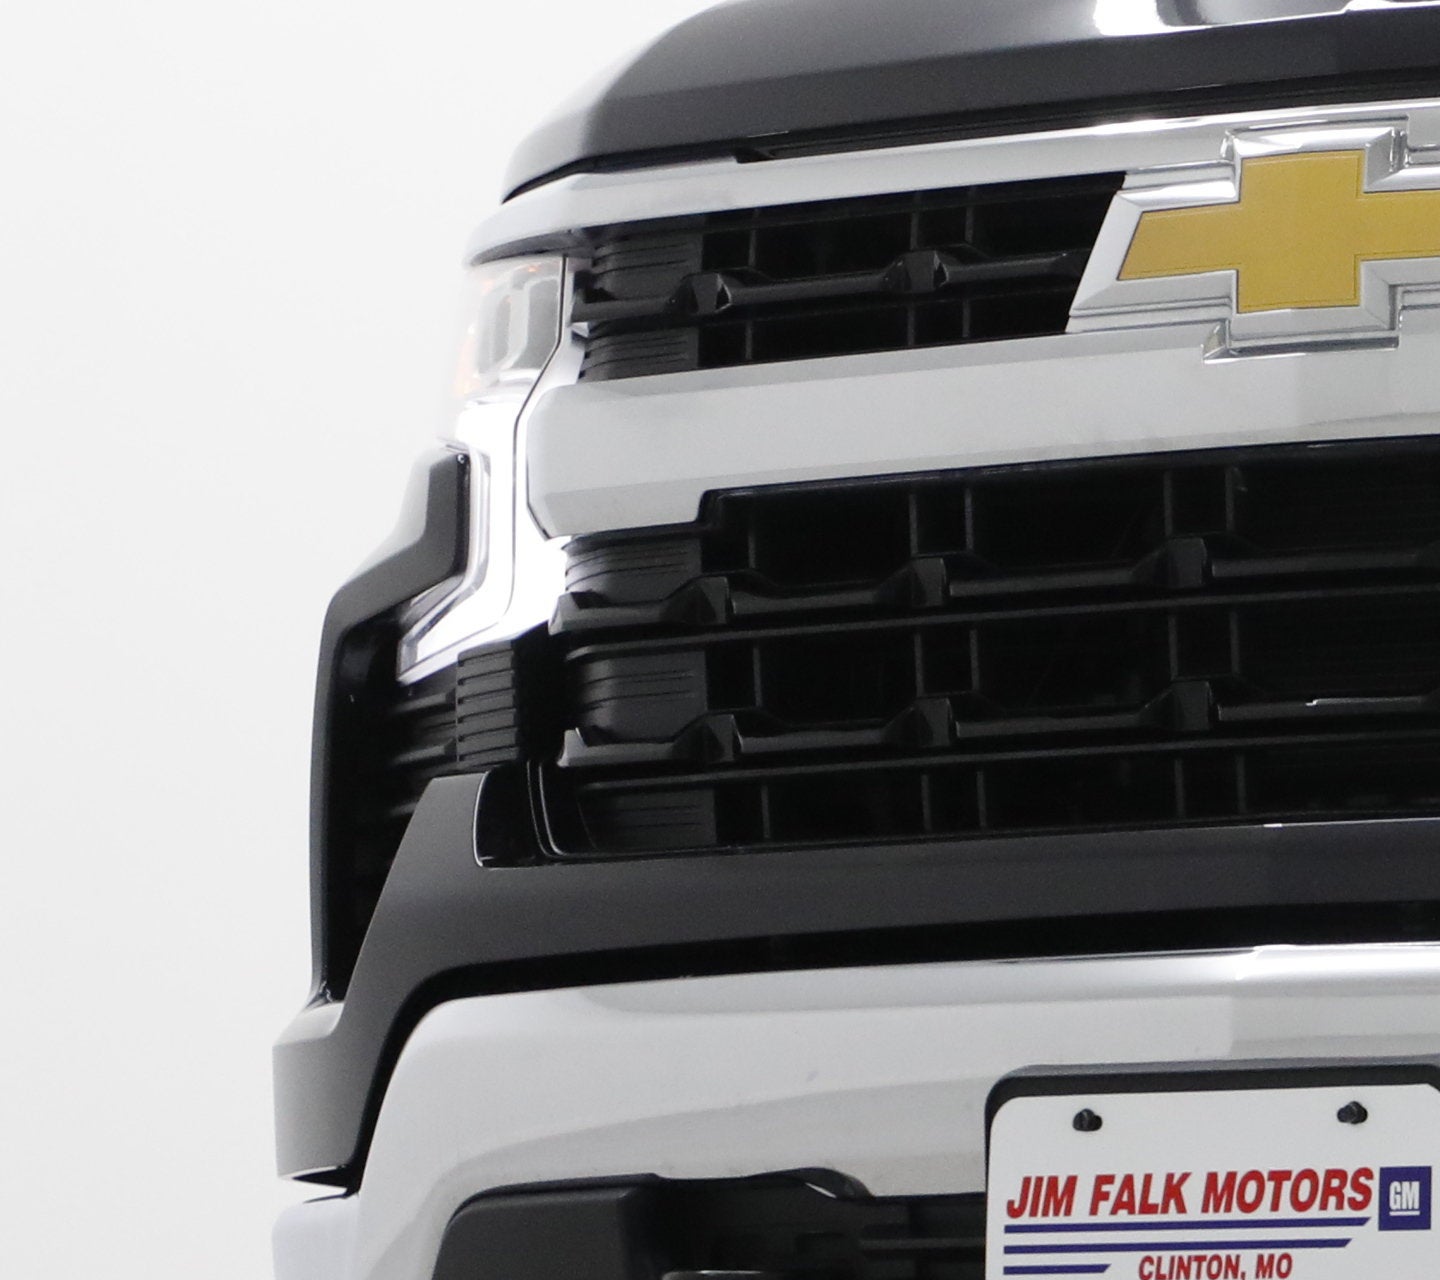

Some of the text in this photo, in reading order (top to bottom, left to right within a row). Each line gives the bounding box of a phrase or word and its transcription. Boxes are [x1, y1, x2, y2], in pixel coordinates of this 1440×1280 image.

[1006, 1167, 1374, 1219] JIM FALK MOTORS
[1389, 1181, 1420, 1211] GM
[1254, 1253, 1293, 1280] MO
